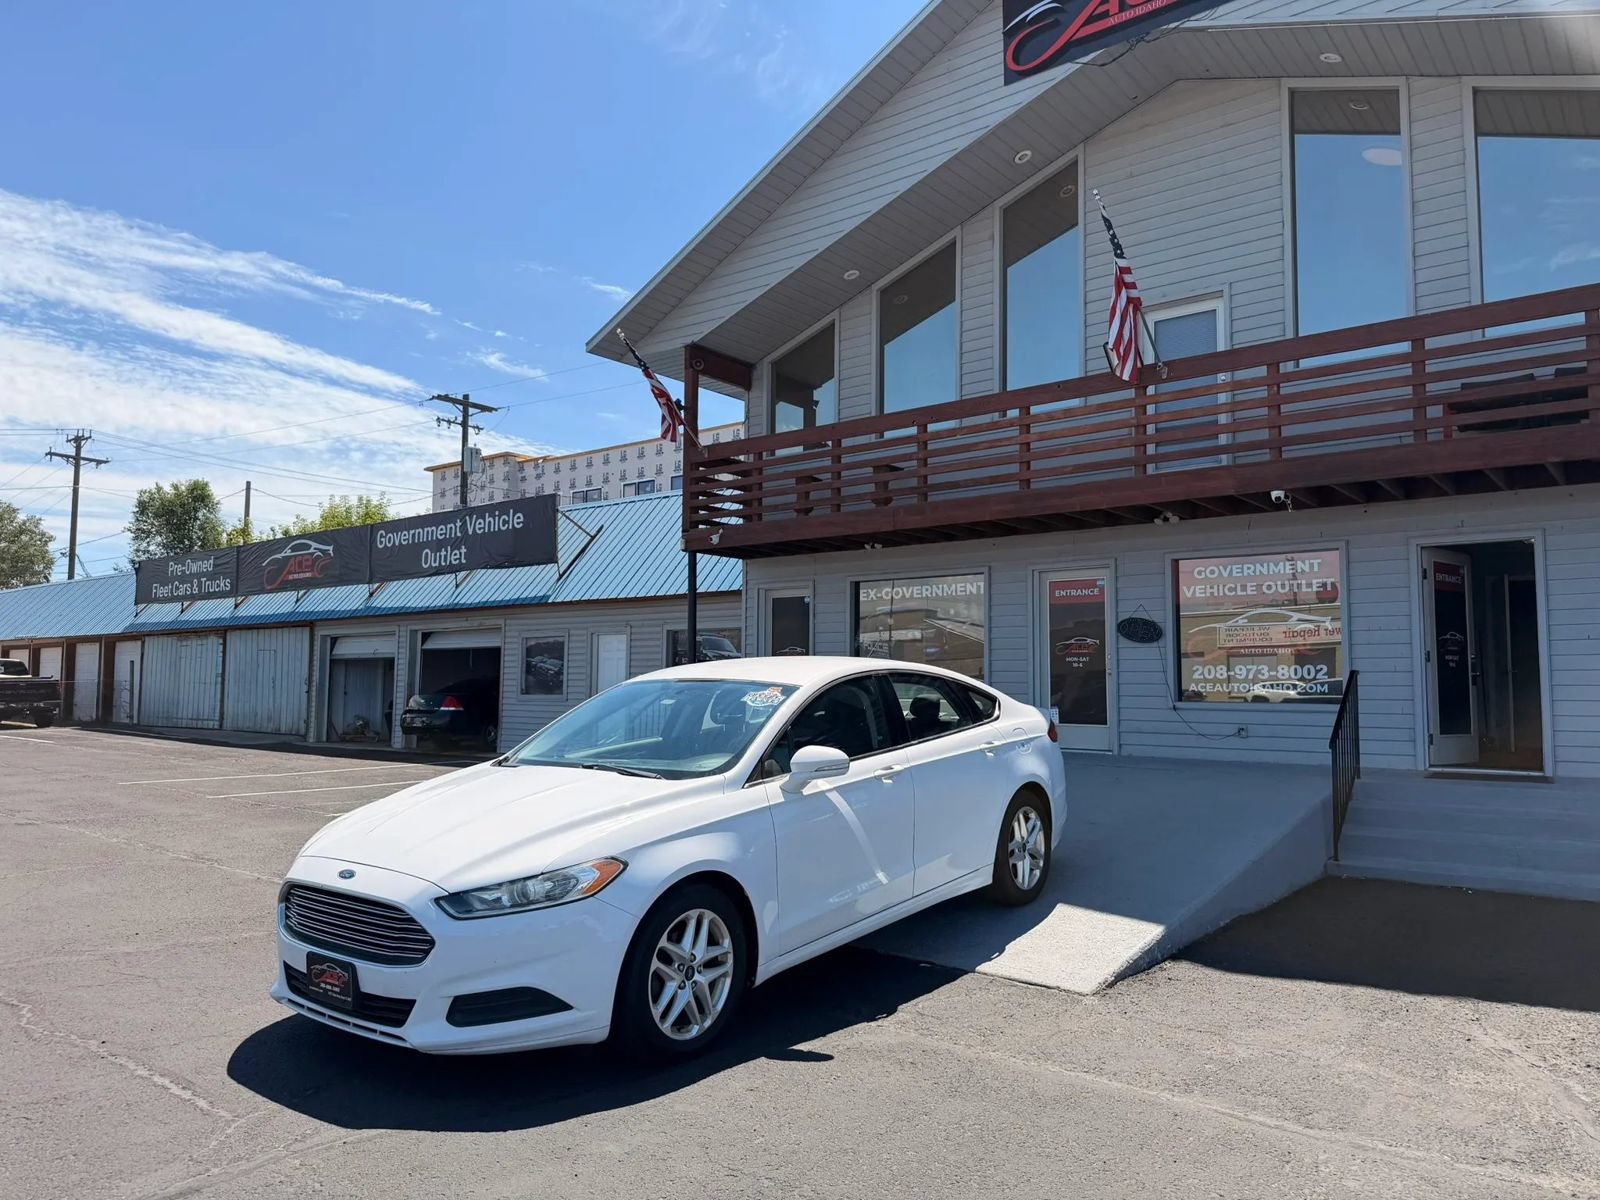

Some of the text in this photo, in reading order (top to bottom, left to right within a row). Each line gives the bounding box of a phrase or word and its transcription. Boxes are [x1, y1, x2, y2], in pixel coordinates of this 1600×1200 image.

[1109, 10, 1135, 25] AUTO
[1135, 0, 1167, 16] IDAHO
[377, 509, 524, 548] Government Vehicle
[168, 556, 213, 576] Pre-Owned
[422, 545, 467, 568] Outlet
[1193, 559, 1321, 579] GOVERNMENT
[152, 576, 231, 598] Fleet Cars & Trucks
[860, 582, 984, 600] EX-GOVERNMENT
[1055, 588, 1100, 597] ENTRANCE
[1183, 578, 1334, 598] VEHICLE OUTLET
[1192, 664, 1328, 680] 208-973-8002
[1189, 683, 1328, 694] ACEAUTOIAHO.COM
